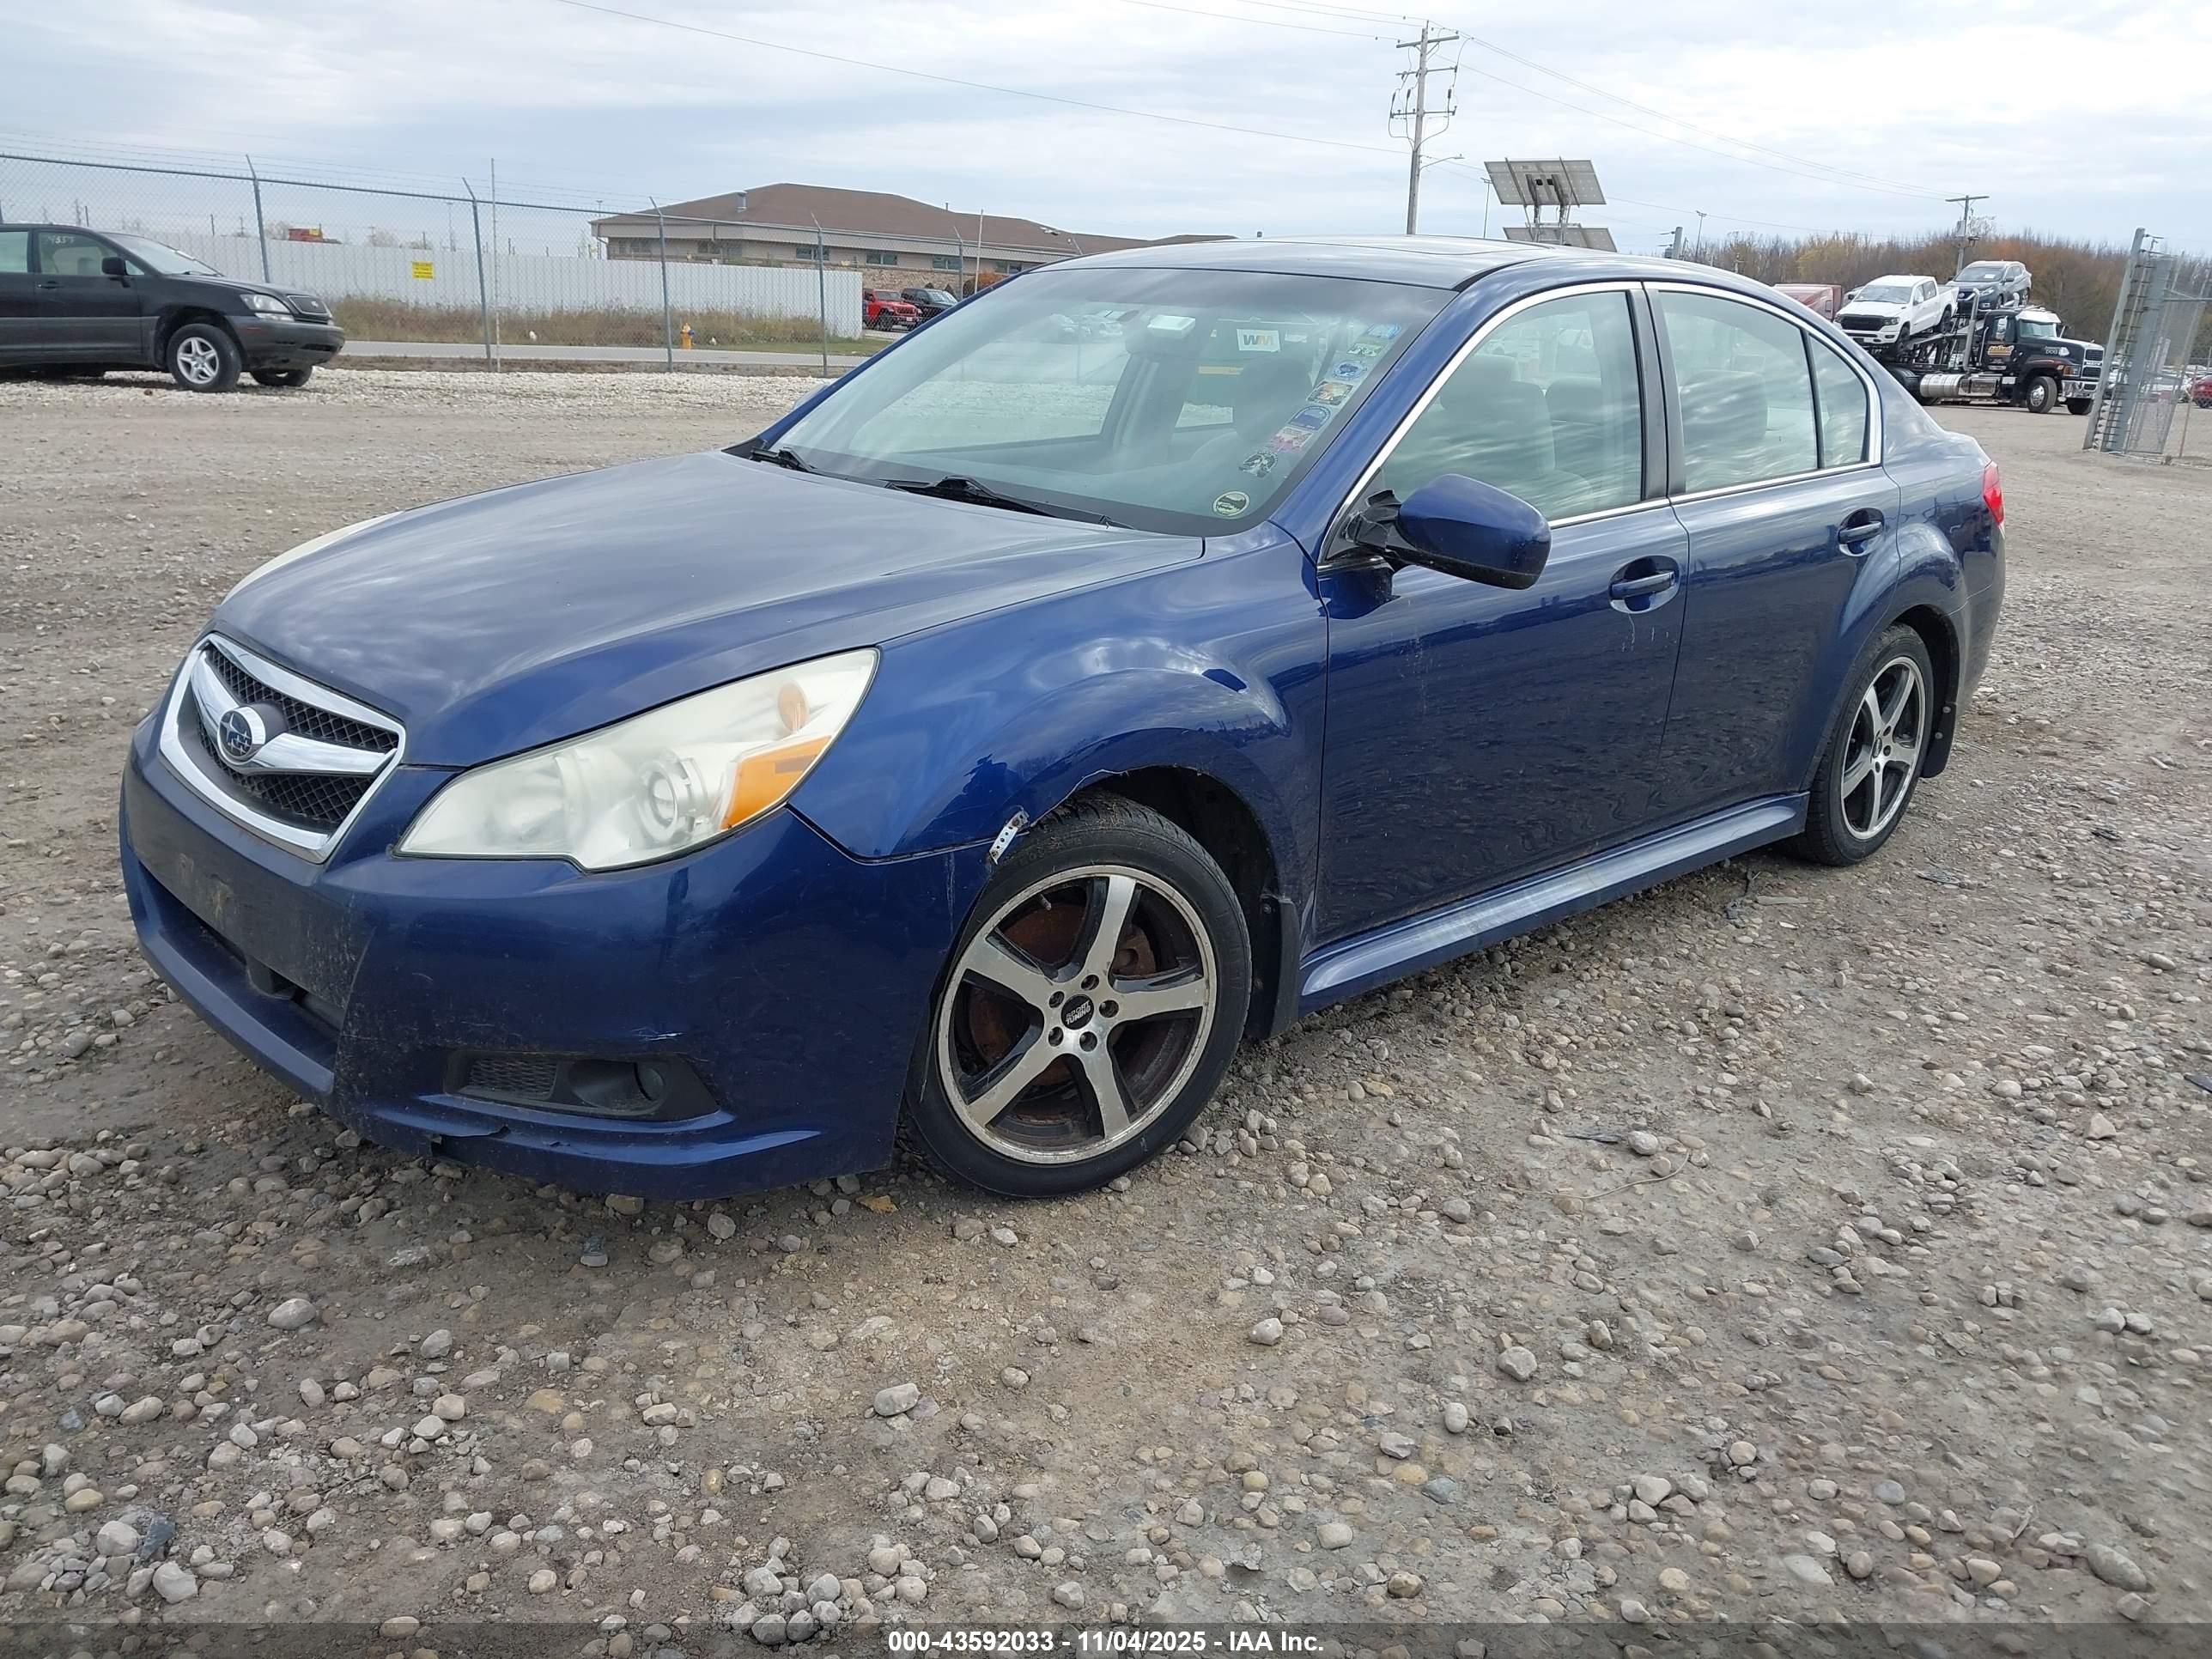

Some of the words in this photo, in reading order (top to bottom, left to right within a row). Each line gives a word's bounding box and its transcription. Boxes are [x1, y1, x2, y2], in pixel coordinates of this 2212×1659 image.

[1243, 334, 1273, 345] WM
[1066, 1000, 1090, 1019] SPORT
[1066, 1005, 1091, 1025] TUNING
